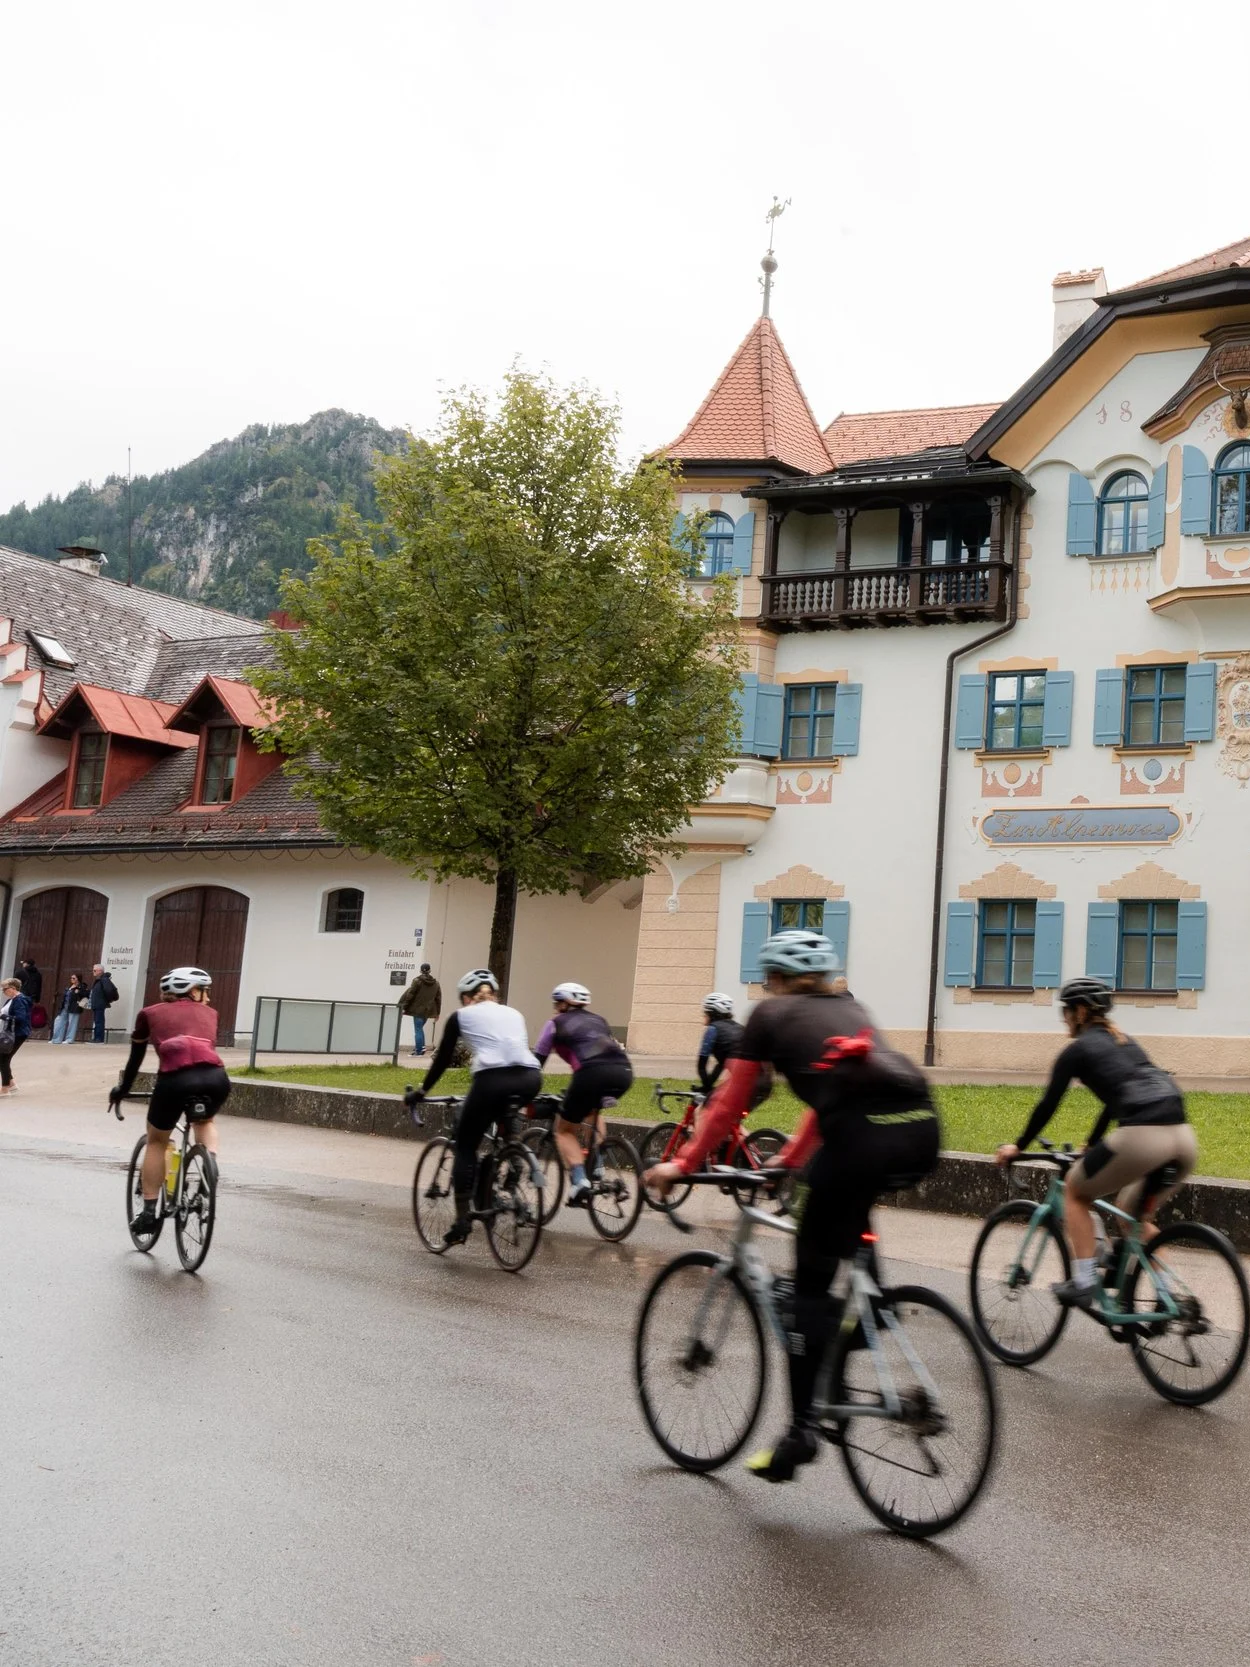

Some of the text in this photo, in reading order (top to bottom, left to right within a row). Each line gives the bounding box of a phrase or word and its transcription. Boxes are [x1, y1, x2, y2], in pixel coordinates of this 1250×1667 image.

[1037, 812, 1167, 841] Alpenrose
[110, 945, 134, 955] Ausfahrt
[388, 949, 415, 958] Einfahrt
[384, 962, 416, 970] freihalten
